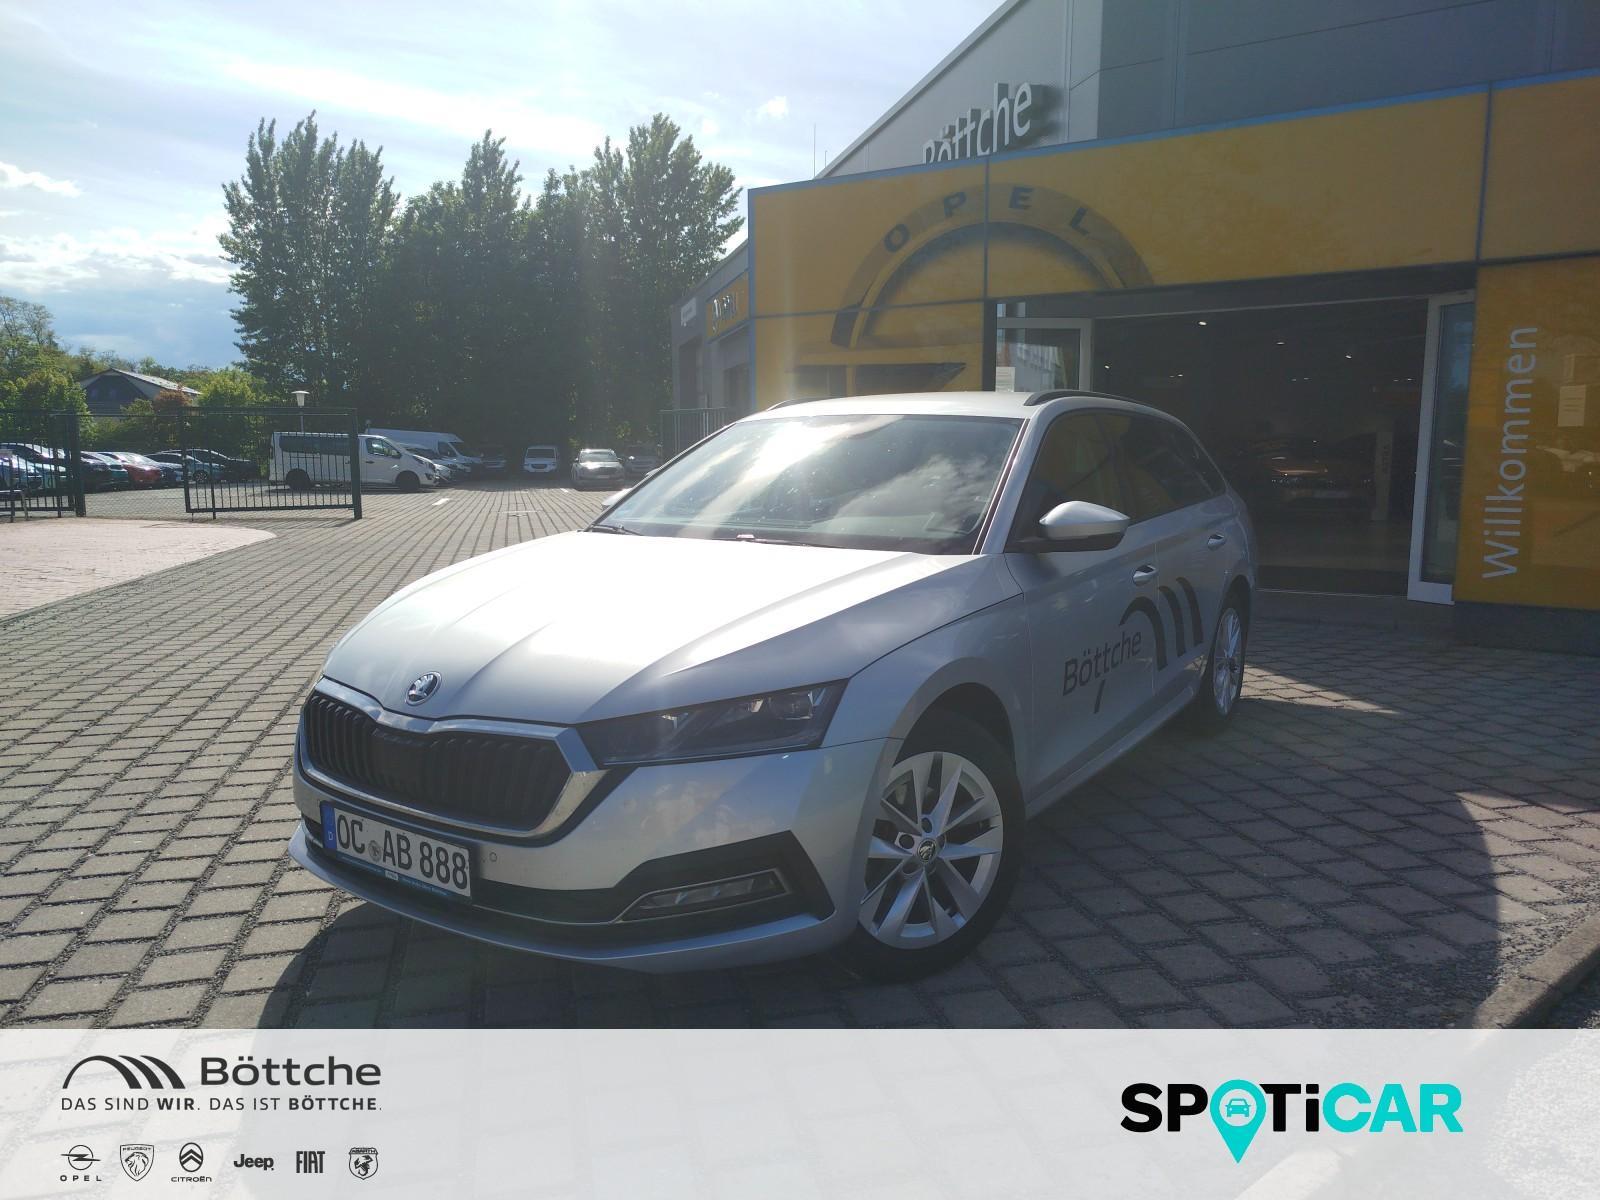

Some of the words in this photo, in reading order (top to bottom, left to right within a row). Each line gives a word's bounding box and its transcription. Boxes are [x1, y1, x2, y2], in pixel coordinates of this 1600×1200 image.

[884, 186, 1092, 253] OPEL
[1481, 326, 1538, 579] Willkommen
[1062, 631, 1142, 696] Böttche
[337, 814, 365, 854] OC
[382, 829, 412, 871] AB
[419, 841, 468, 890] 888
